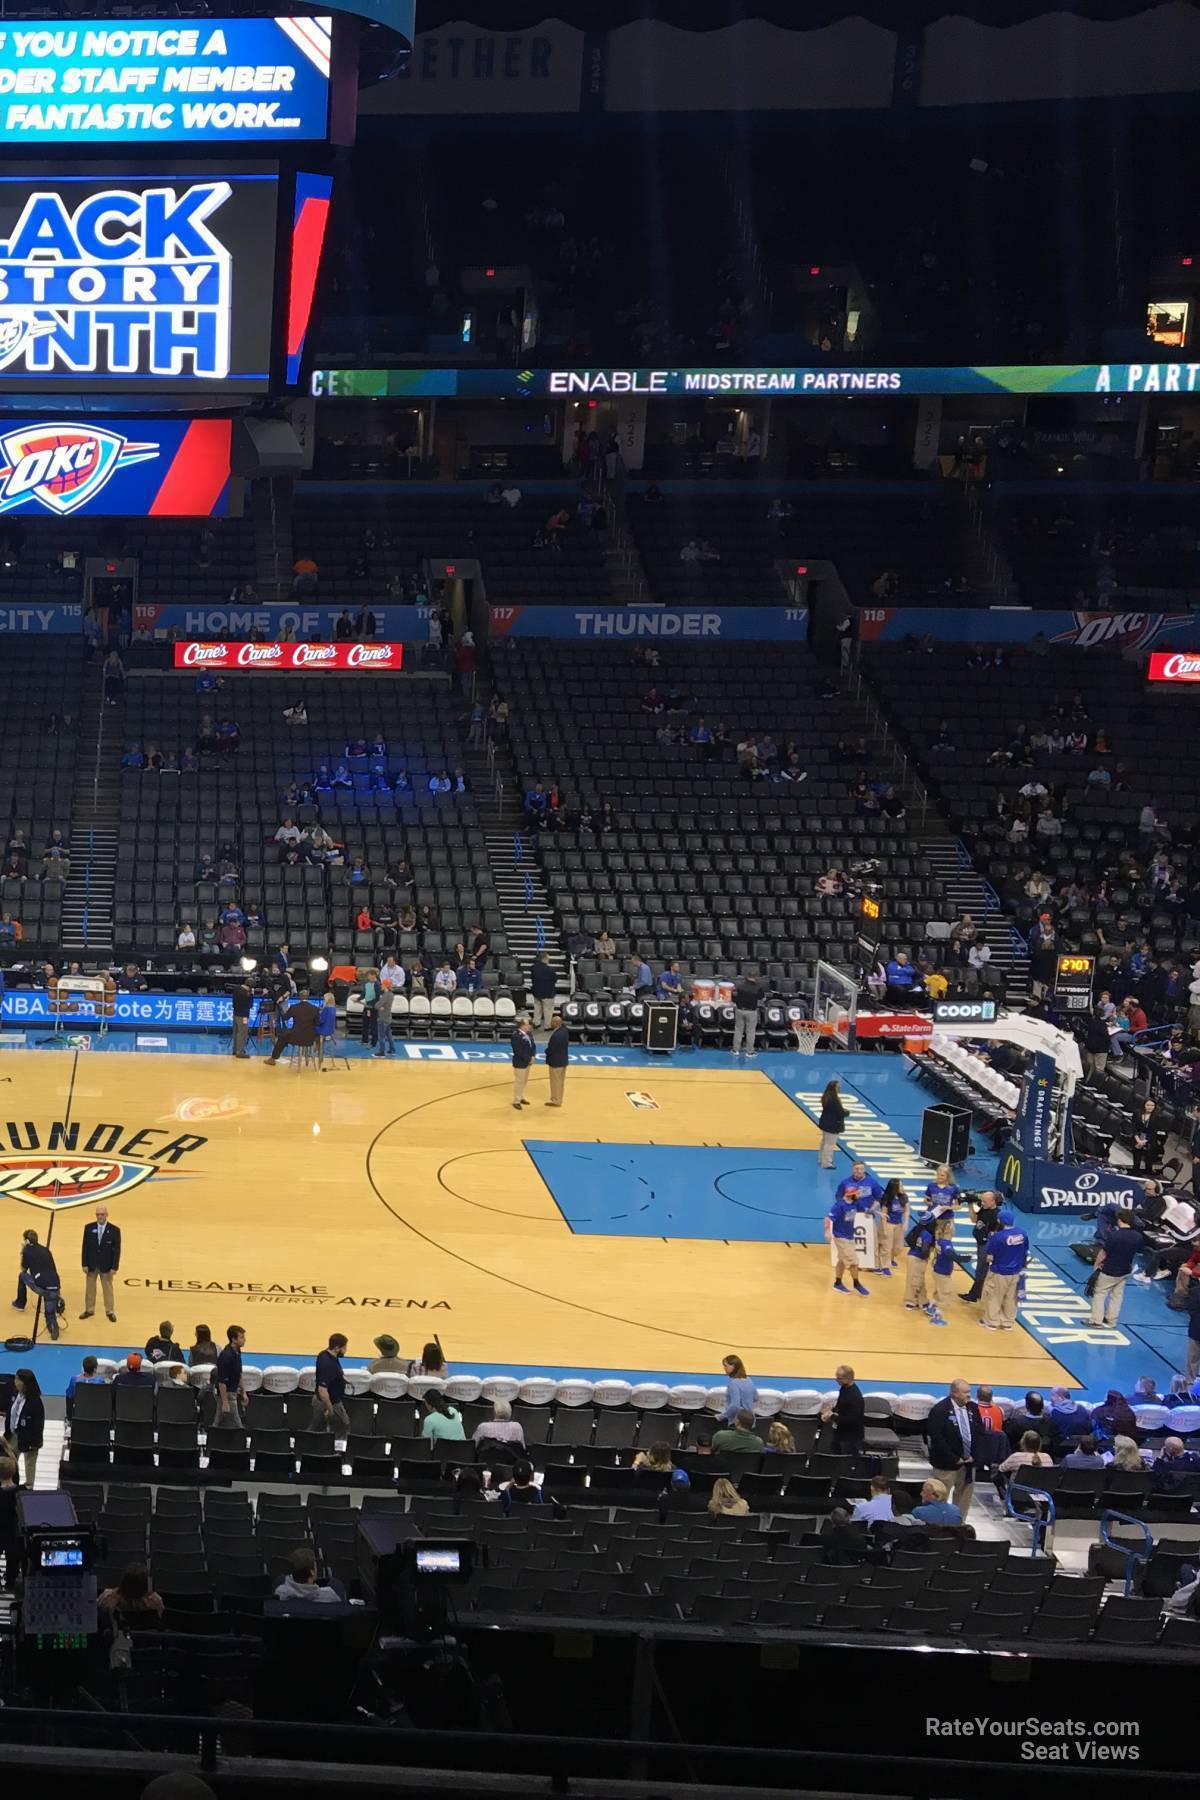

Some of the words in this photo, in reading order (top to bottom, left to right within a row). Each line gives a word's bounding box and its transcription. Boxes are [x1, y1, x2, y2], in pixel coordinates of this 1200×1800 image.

[13, 32, 77, 57] YOU
[84, 31, 199, 56] NOTICE
[204, 31, 227, 56] A
[402, 37, 550, 81] ETHER
[61, 68, 159, 93] STAFF
[165, 66, 295, 92] MEMBER
[6, 104, 177, 130] FANTASTIC
[183, 103, 300, 129] WORK...
[549, 371, 669, 393] ENABLE
[685, 373, 797, 390] MIDSTREAM
[803, 372, 902, 390] PARTNERS
[1096, 364, 1111, 392] A
[1128, 363, 1200, 392] PART
[9, 441, 99, 486] OKC
[62, 605, 82, 617] 115
[135, 606, 156, 618] 116
[493, 607, 514, 619] 117
[784, 608, 807, 620] 117
[864, 610, 885, 622] 118
[185, 612, 270, 633] HOME
[280, 612, 311, 633] OF
[574, 612, 722, 635] THUNDER
[1074, 613, 1146, 647] OKC
[184, 643, 229, 665] Cane's
[237, 643, 283, 665] Cane's
[292, 644, 338, 666] Cane's
[347, 644, 394, 666] Cane's
[1060, 959, 1090, 972] 2707
[566, 1003, 578, 1016] G
[587, 1003, 598, 1016] G
[609, 1004, 621, 1017] G
[631, 1004, 643, 1017] G
[699, 1006, 711, 1018] G
[722, 1007, 734, 1020] G
[768, 1008, 780, 1021] G
[788, 1008, 801, 1020] G
[937, 1005, 982, 1018] COOP
[1033, 1090, 1046, 1148] DRAFTKINGS
[1040, 1187, 1134, 1210] SPALDING
[854, 1226, 867, 1255] GET
[123, 1277, 329, 1295] CHESAPEAKE
[246, 1294, 330, 1304] ENERGY
[335, 1295, 453, 1311] ARENA
